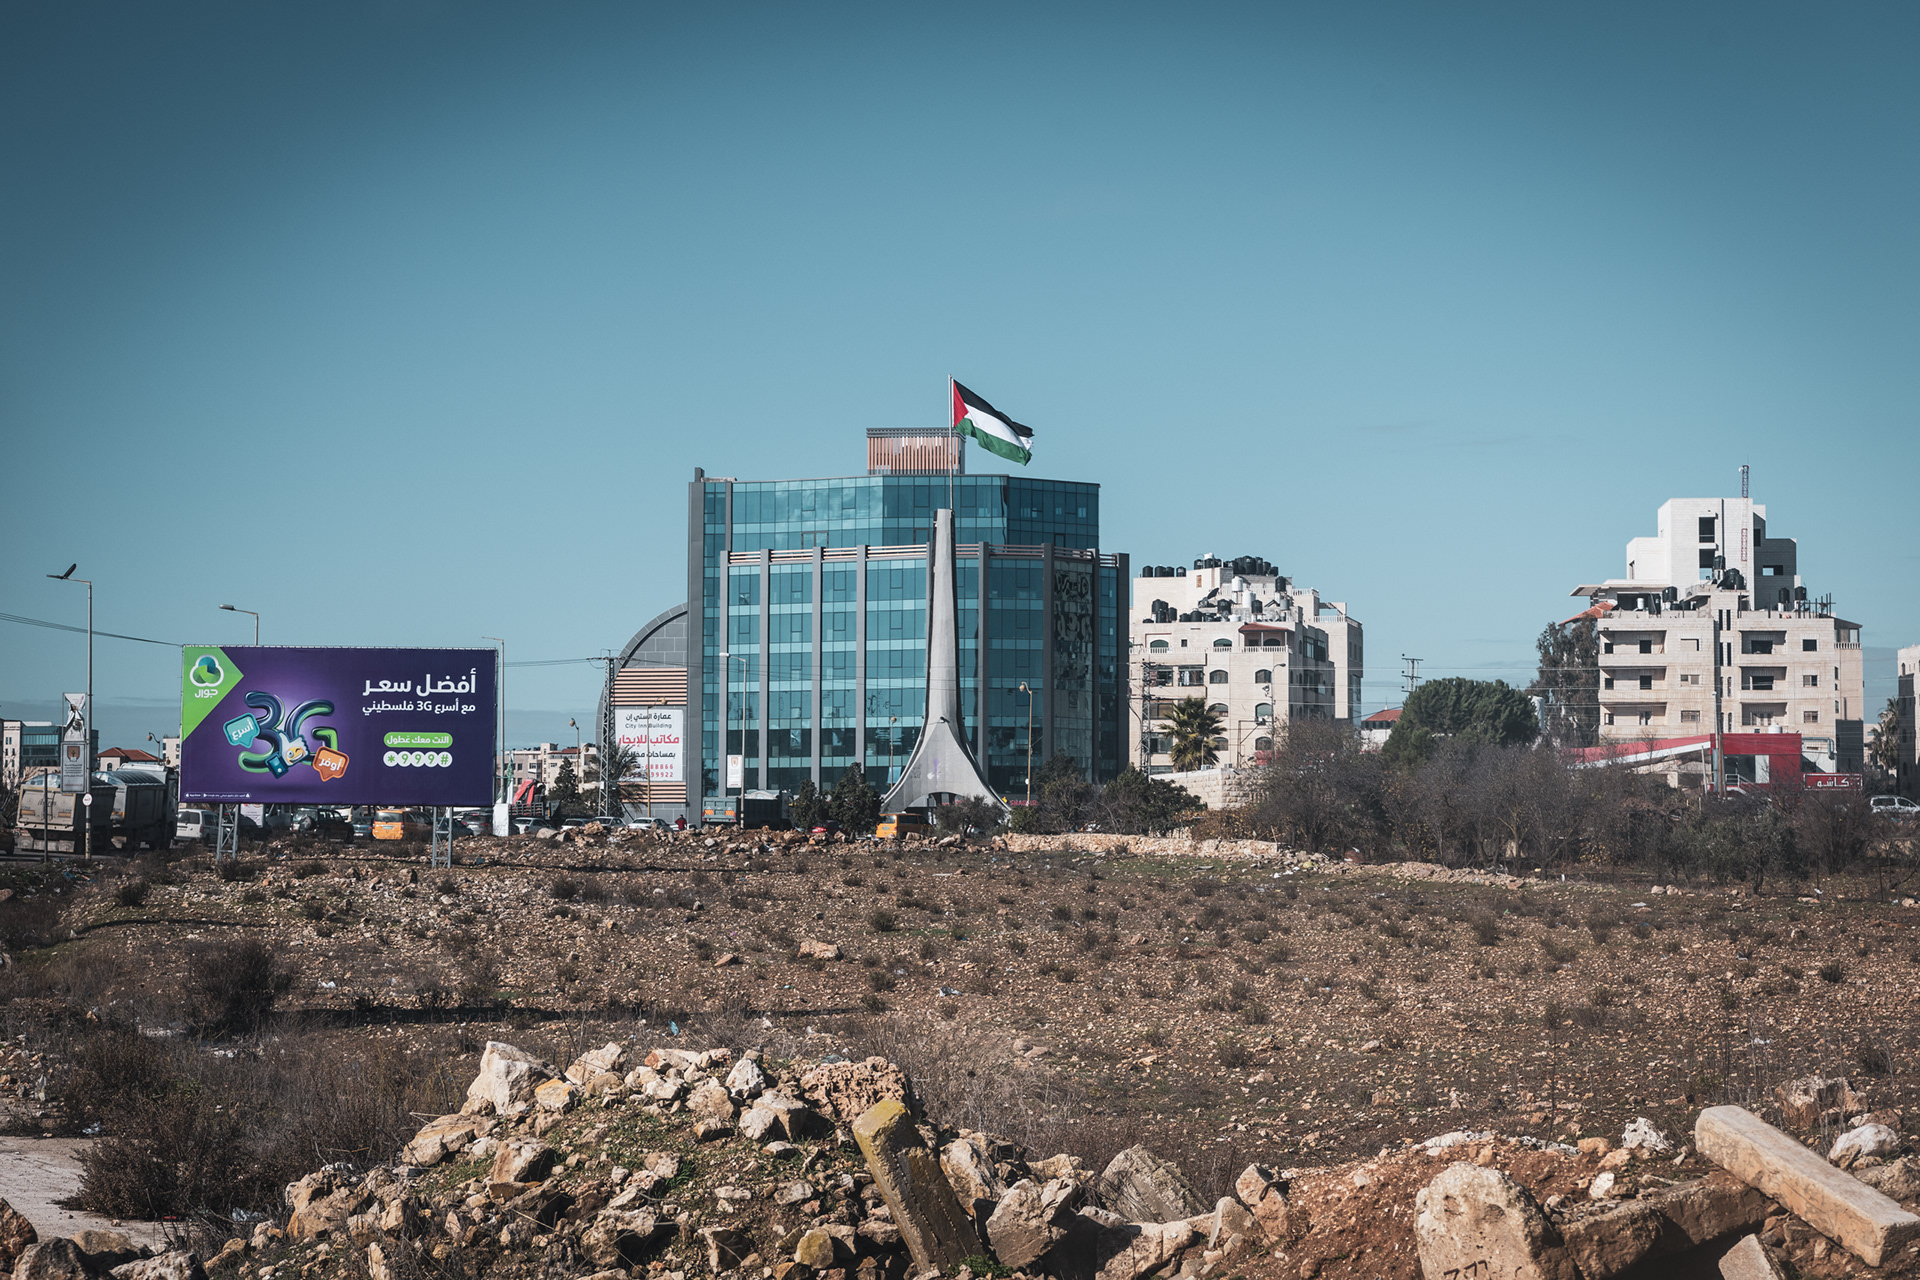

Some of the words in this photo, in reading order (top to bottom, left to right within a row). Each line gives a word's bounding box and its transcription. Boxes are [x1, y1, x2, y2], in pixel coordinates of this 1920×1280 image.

[362, 679, 412, 697] سعر
[416, 667, 477, 697] أفضل
[194, 688, 219, 699] جوال
[362, 699, 415, 717] فلسطيني
[416, 700, 433, 712] 3G
[434, 697, 459, 715] أسرع
[461, 704, 476, 715] مع
[626, 713, 632, 721] إن
[653, 713, 671, 721] عمارة
[231, 717, 255, 741] أسرع
[411, 735, 431, 744] معك
[432, 735, 450, 745] النت
[619, 734, 647, 747] للإيجار
[650, 734, 679, 746] مكاتب
[318, 757, 343, 772] أوفر
